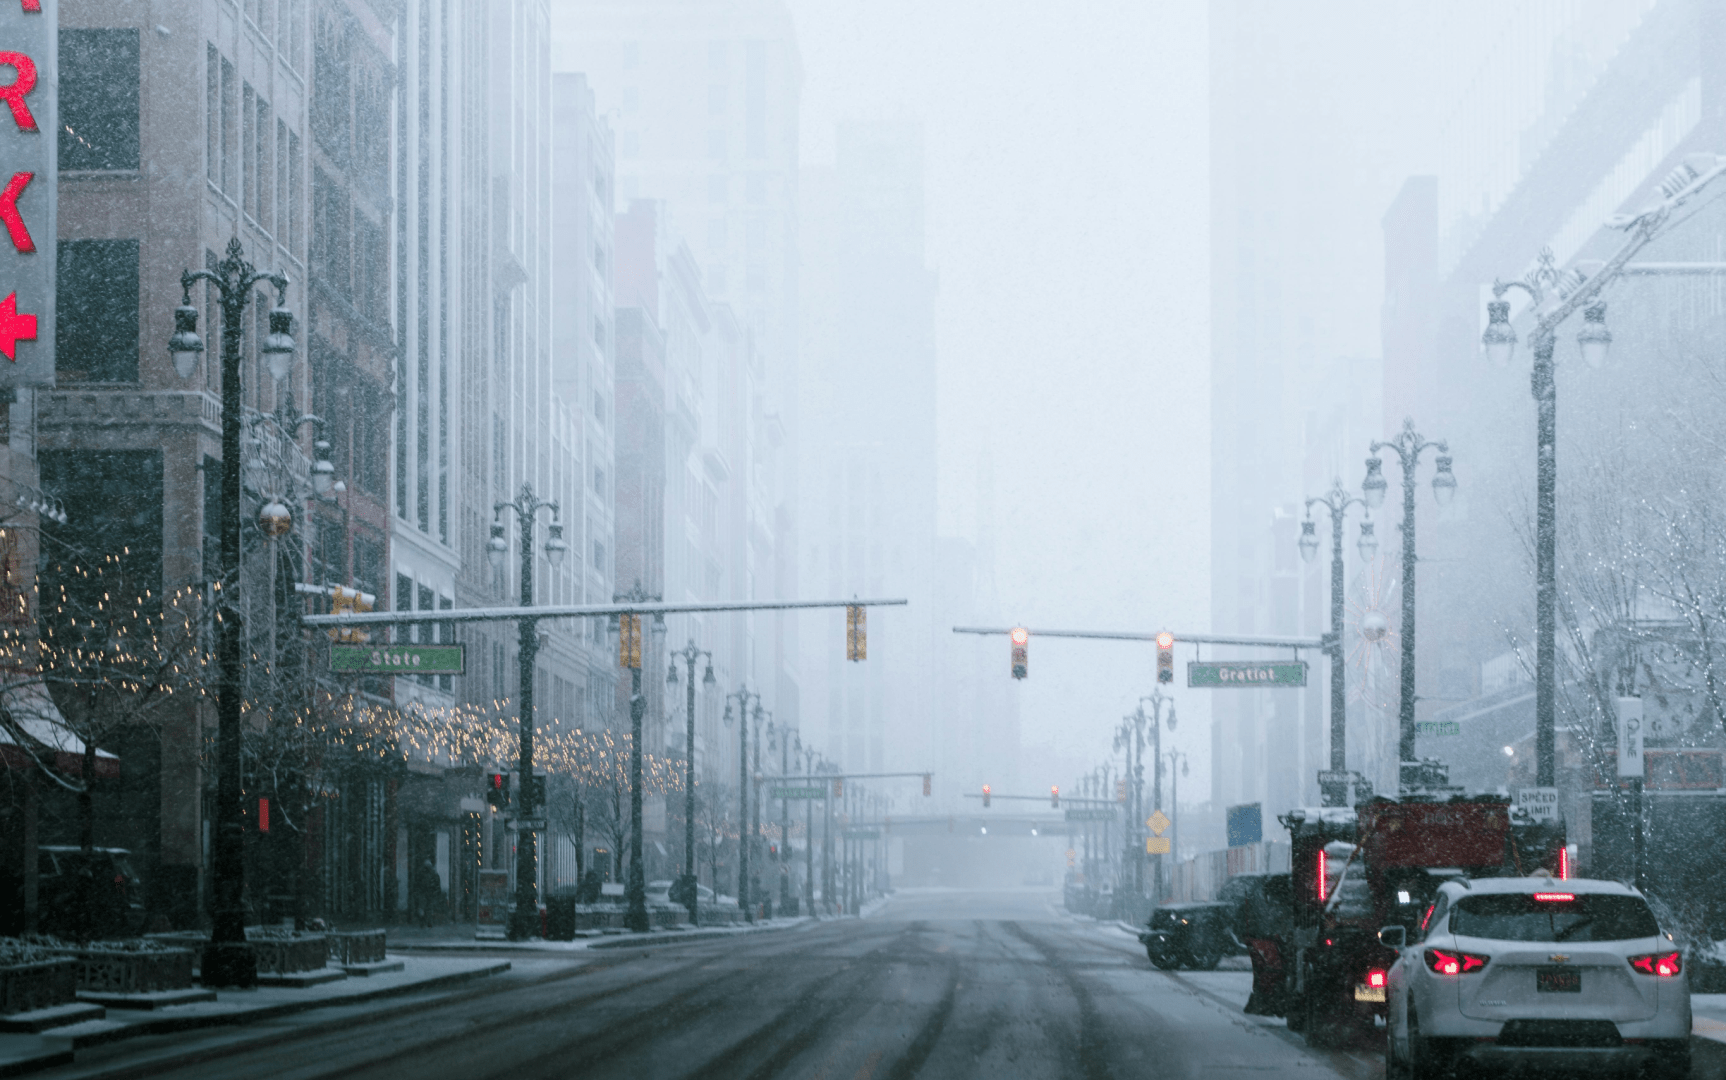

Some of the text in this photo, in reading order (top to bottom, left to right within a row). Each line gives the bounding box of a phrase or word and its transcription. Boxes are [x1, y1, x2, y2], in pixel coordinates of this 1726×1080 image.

[371, 651, 421, 666] State
[1219, 667, 1275, 681] Gratiot
[1521, 792, 1556, 803] SPEED
[1530, 805, 1552, 815] IMIT
